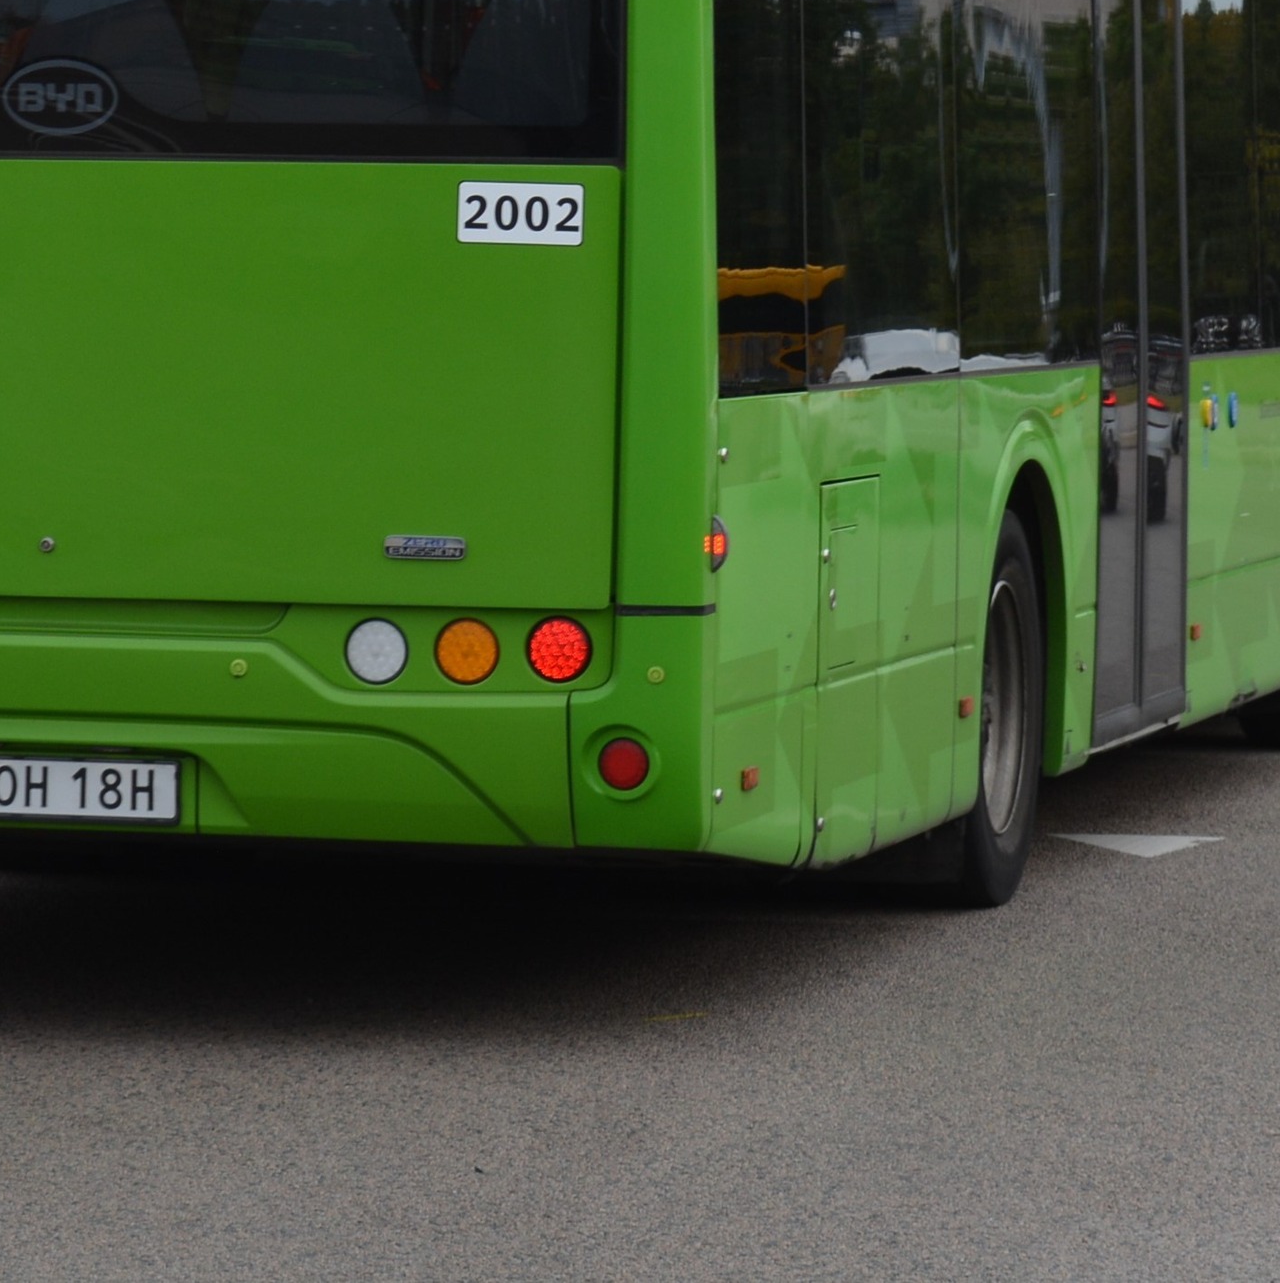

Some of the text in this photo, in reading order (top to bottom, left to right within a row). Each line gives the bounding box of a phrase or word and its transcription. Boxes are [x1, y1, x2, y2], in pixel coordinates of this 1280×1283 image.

[18, 82, 103, 112] BYD
[464, 194, 580, 233] 2002
[388, 546, 461, 557] EMISSION
[71, 767, 155, 812] 18H
